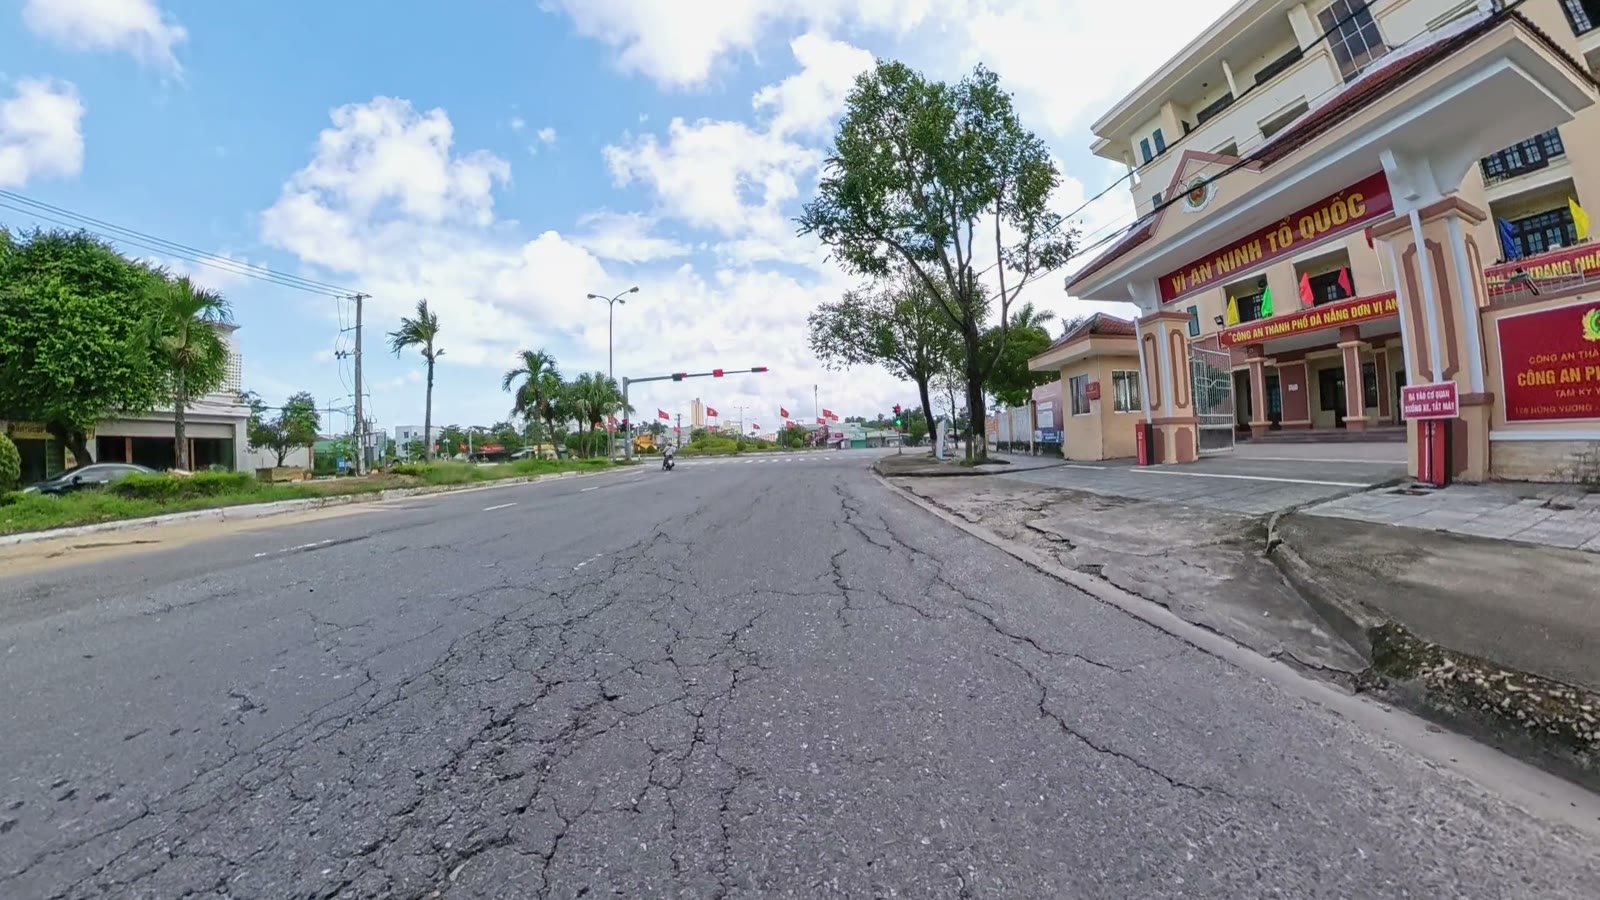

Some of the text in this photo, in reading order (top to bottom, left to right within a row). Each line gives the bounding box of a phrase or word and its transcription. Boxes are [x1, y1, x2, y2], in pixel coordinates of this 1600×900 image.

[1172, 191, 1368, 293] VÌ AN NINH TỔ QUỐC
[1253, 328, 1264, 341] AN
[1265, 321, 1291, 338] THÀNH
[1292, 314, 1309, 329] PHỐ
[1310, 314, 1322, 328] ĐÀ
[1373, 301, 1384, 315] VỊ
[1529, 353, 1558, 364] CÔNG
[1561, 351, 1576, 361] AN
[1517, 368, 1556, 387] CÔNG
[1560, 367, 1581, 384] AN
